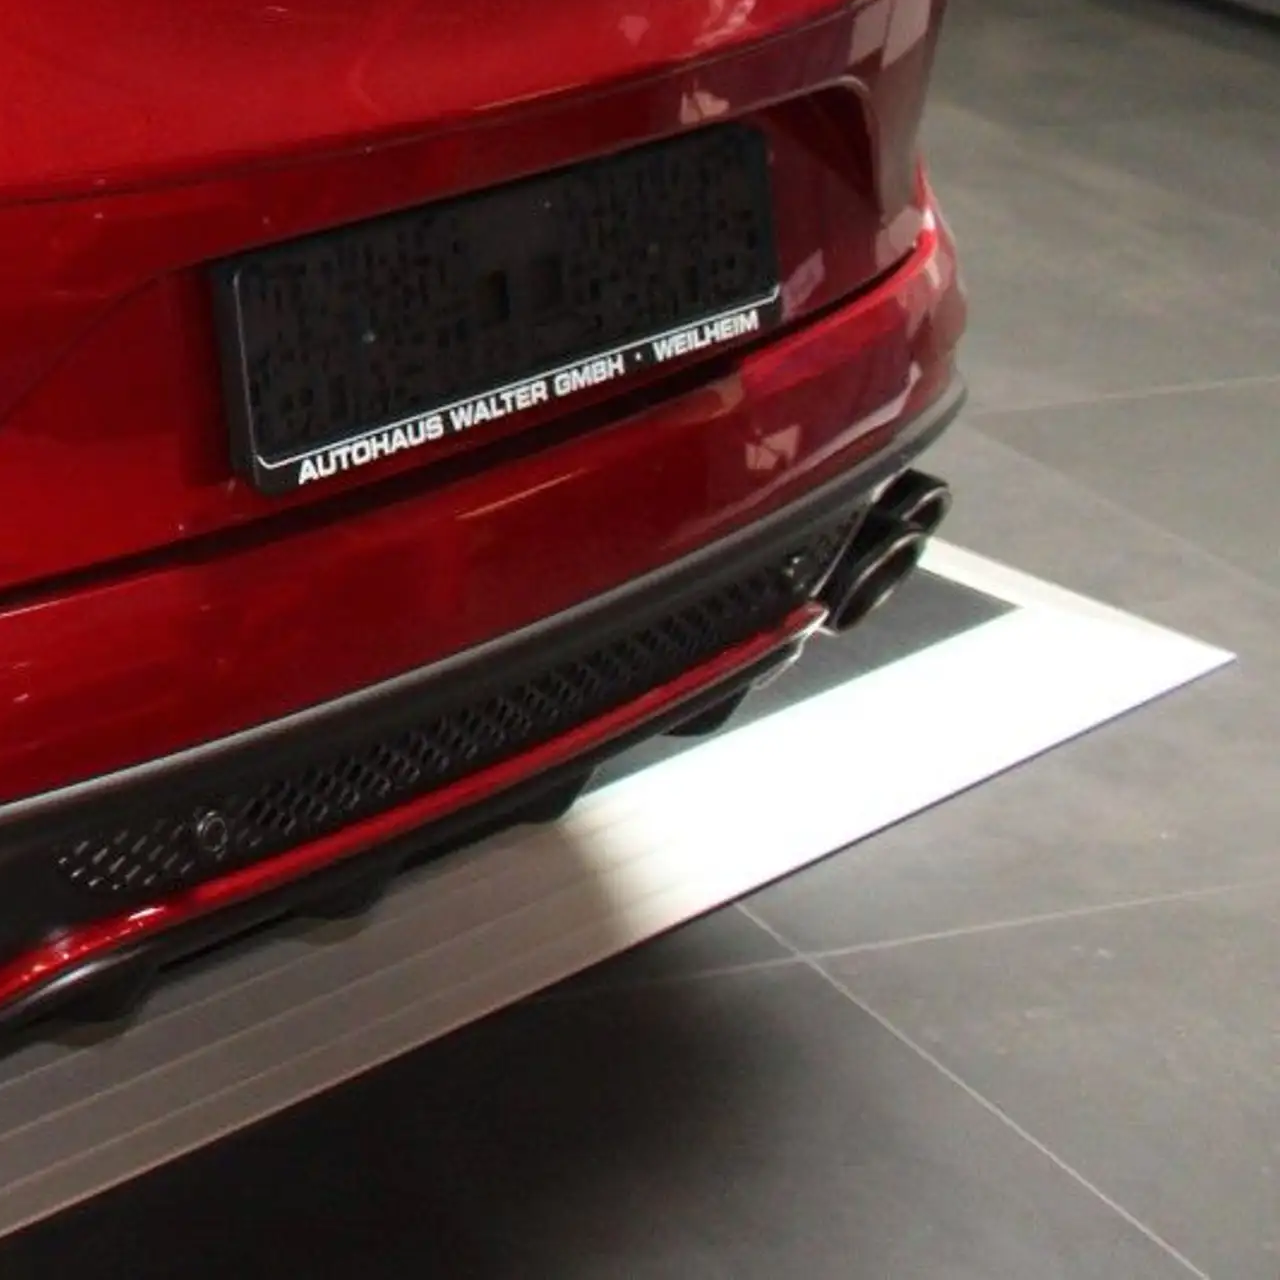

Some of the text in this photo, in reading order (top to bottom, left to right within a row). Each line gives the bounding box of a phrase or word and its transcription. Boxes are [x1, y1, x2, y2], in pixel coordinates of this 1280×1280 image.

[297, 309, 760, 485] AUTOHAUS WALTER GMBH WEILHEIM
